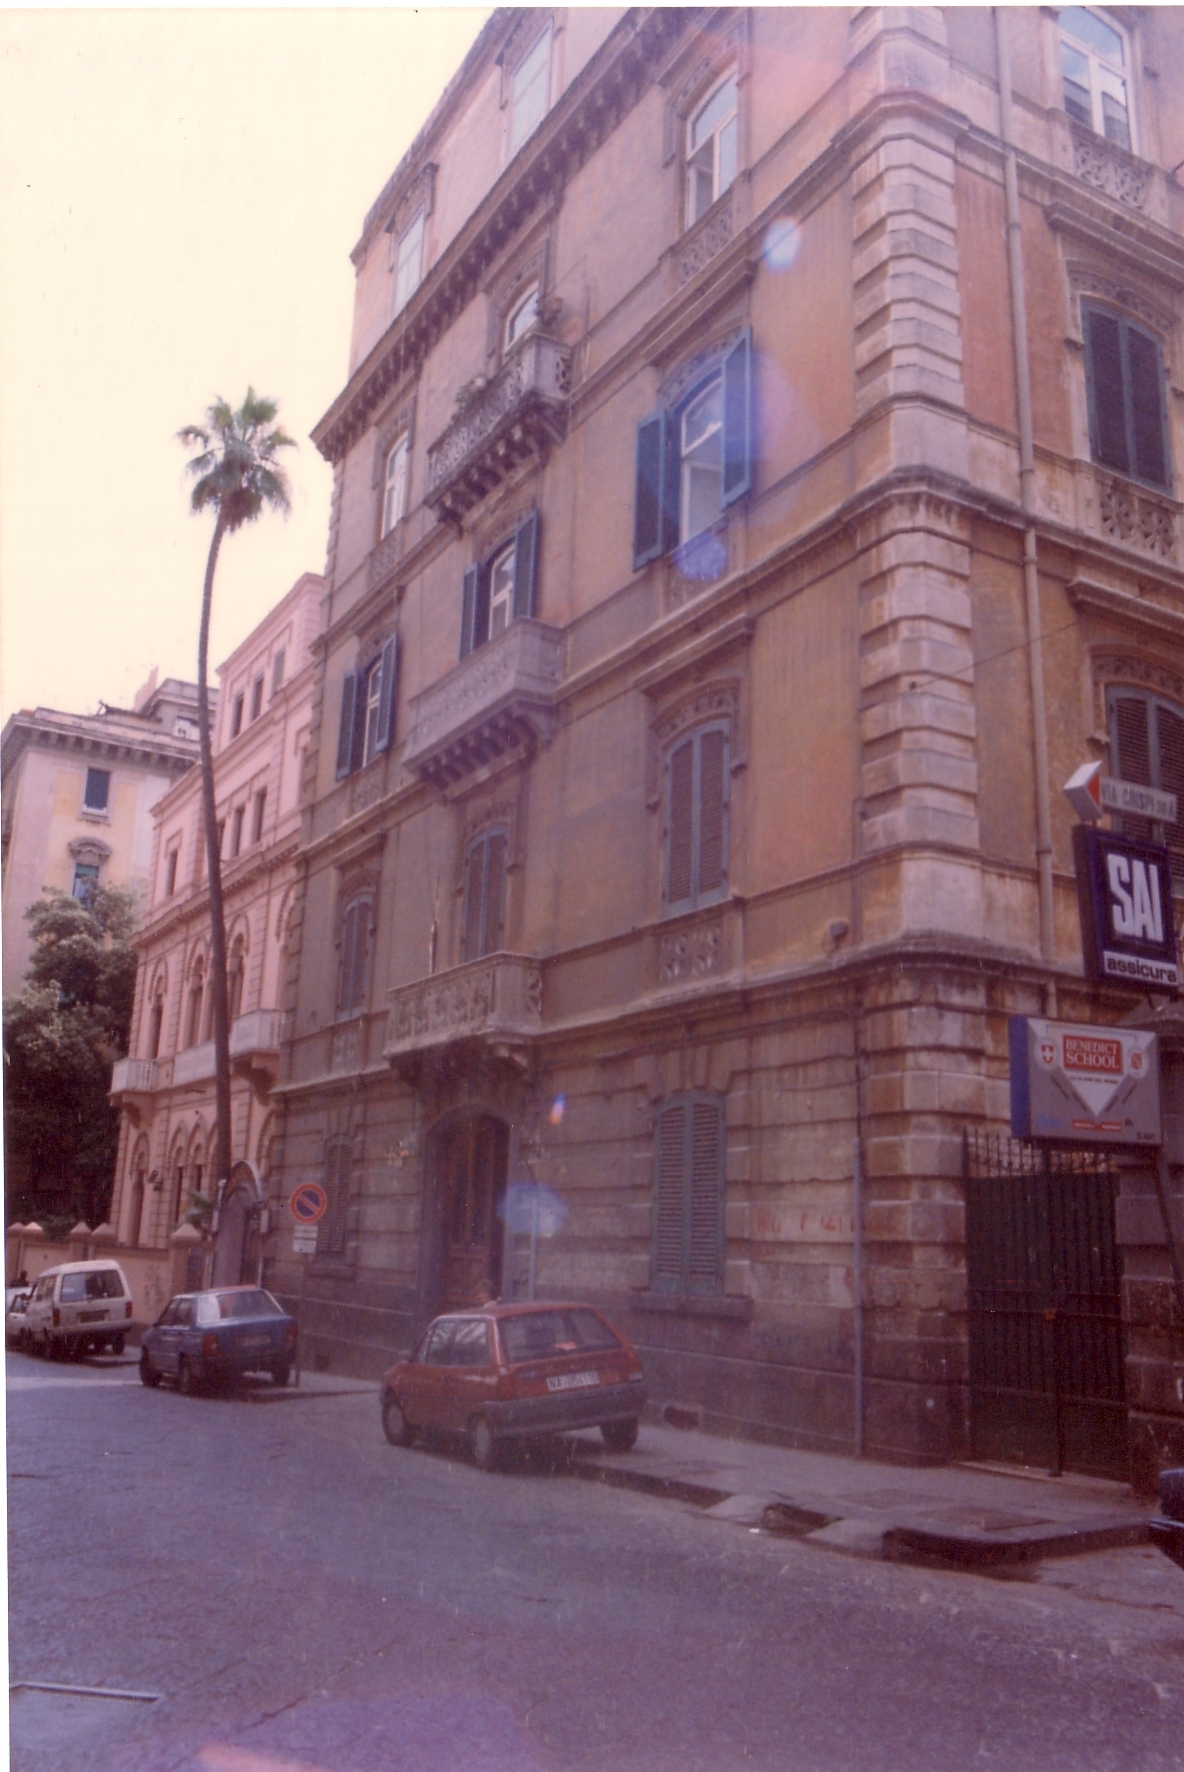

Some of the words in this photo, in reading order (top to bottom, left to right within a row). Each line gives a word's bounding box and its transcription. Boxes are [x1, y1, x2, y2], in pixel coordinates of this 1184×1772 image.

[1107, 853, 1164, 942] SAI
[1107, 956, 1177, 983] assicura
[1065, 1038, 1118, 1055] BENEDICT
[1066, 1053, 1119, 1068] SCHOOL
